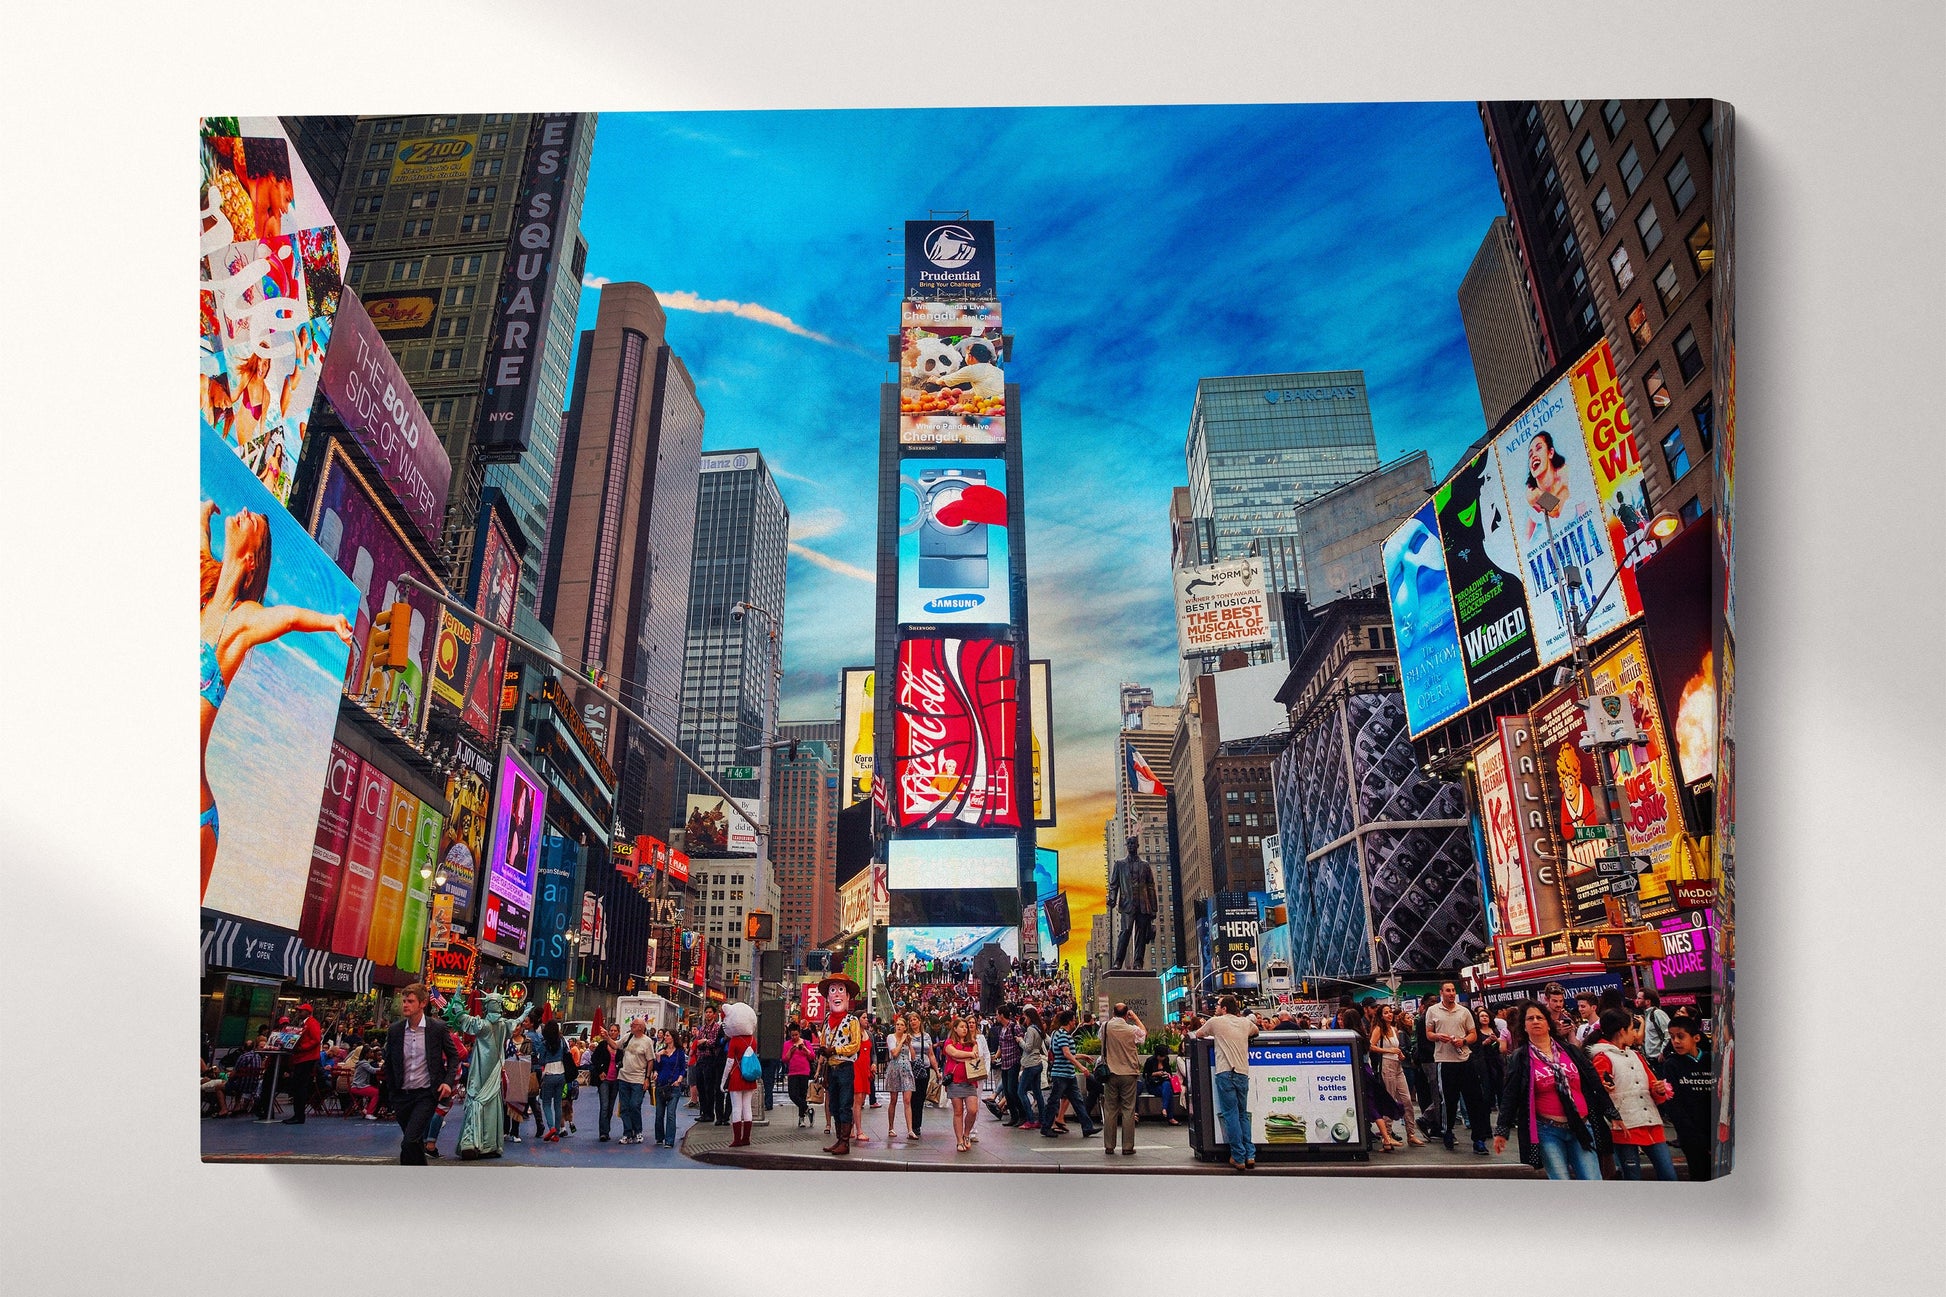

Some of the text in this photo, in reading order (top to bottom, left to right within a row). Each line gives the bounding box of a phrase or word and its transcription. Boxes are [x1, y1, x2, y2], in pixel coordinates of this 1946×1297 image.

[404, 140, 467, 164] Z100
[920, 271, 981, 281] Prudential
[496, 193, 551, 386] SQUARE
[356, 332, 419, 449] THE BOLD
[1283, 386, 1358, 402] BARCLAYS
[489, 411, 515, 422] NYC
[1514, 395, 1550, 434] THE FUN
[1506, 397, 1565, 456] NEVER STOPS!
[346, 370, 435, 519] SIDE OF WATER
[931, 599, 979, 608] SAMSUNG
[1184, 596, 1211, 604] WINNER
[1234, 588, 1261, 598] AWARDS
[1185, 596, 1262, 613] BEST MUSICAL
[1221, 604, 1262, 621] BEST
[1187, 616, 1264, 636] MUSICAL OF
[1188, 633, 1213, 645] THIS
[437, 629, 458, 680] Q
[1621, 652, 1635, 671] Jessie
[1406, 643, 1457, 686] PHANTOM
[1619, 662, 1643, 687] MUELLER
[1417, 680, 1452, 710] OPERA
[462, 747, 476, 766] JOY
[324, 753, 356, 802] ICE
[734, 768, 743, 778] 46
[1624, 767, 1657, 804] NICE
[360, 775, 387, 821] ICE
[741, 801, 750, 811] By
[1514, 729, 1554, 884] PALACE
[390, 795, 414, 836] ICE
[418, 814, 438, 851] ICE
[1576, 830, 1584, 839] W
[1586, 827, 1597, 838] 46
[552, 868, 571, 878] Stanley
[1602, 862, 1617, 871] ONE
[1613, 883, 1623, 892] ONE
[1226, 920, 1259, 938] HERO
[258, 941, 275, 951] WE'RE
[1229, 943, 1250, 951] JUNE 6
[256, 950, 271, 960] OPEN
[338, 962, 353, 973] WE'RE
[1660, 953, 1707, 978] SQUARE
[336, 972, 349, 982] OPEN
[1498, 992, 1513, 1001] OFFICE
[1512, 990, 1525, 1000] HERE
[1265, 1049, 1346, 1060] Green and Clean!
[1267, 1075, 1297, 1084] recycle
[1316, 1074, 1347, 1083] recycle
[1318, 1083, 1347, 1092] bottles
[1319, 1094, 1326, 1102] &
